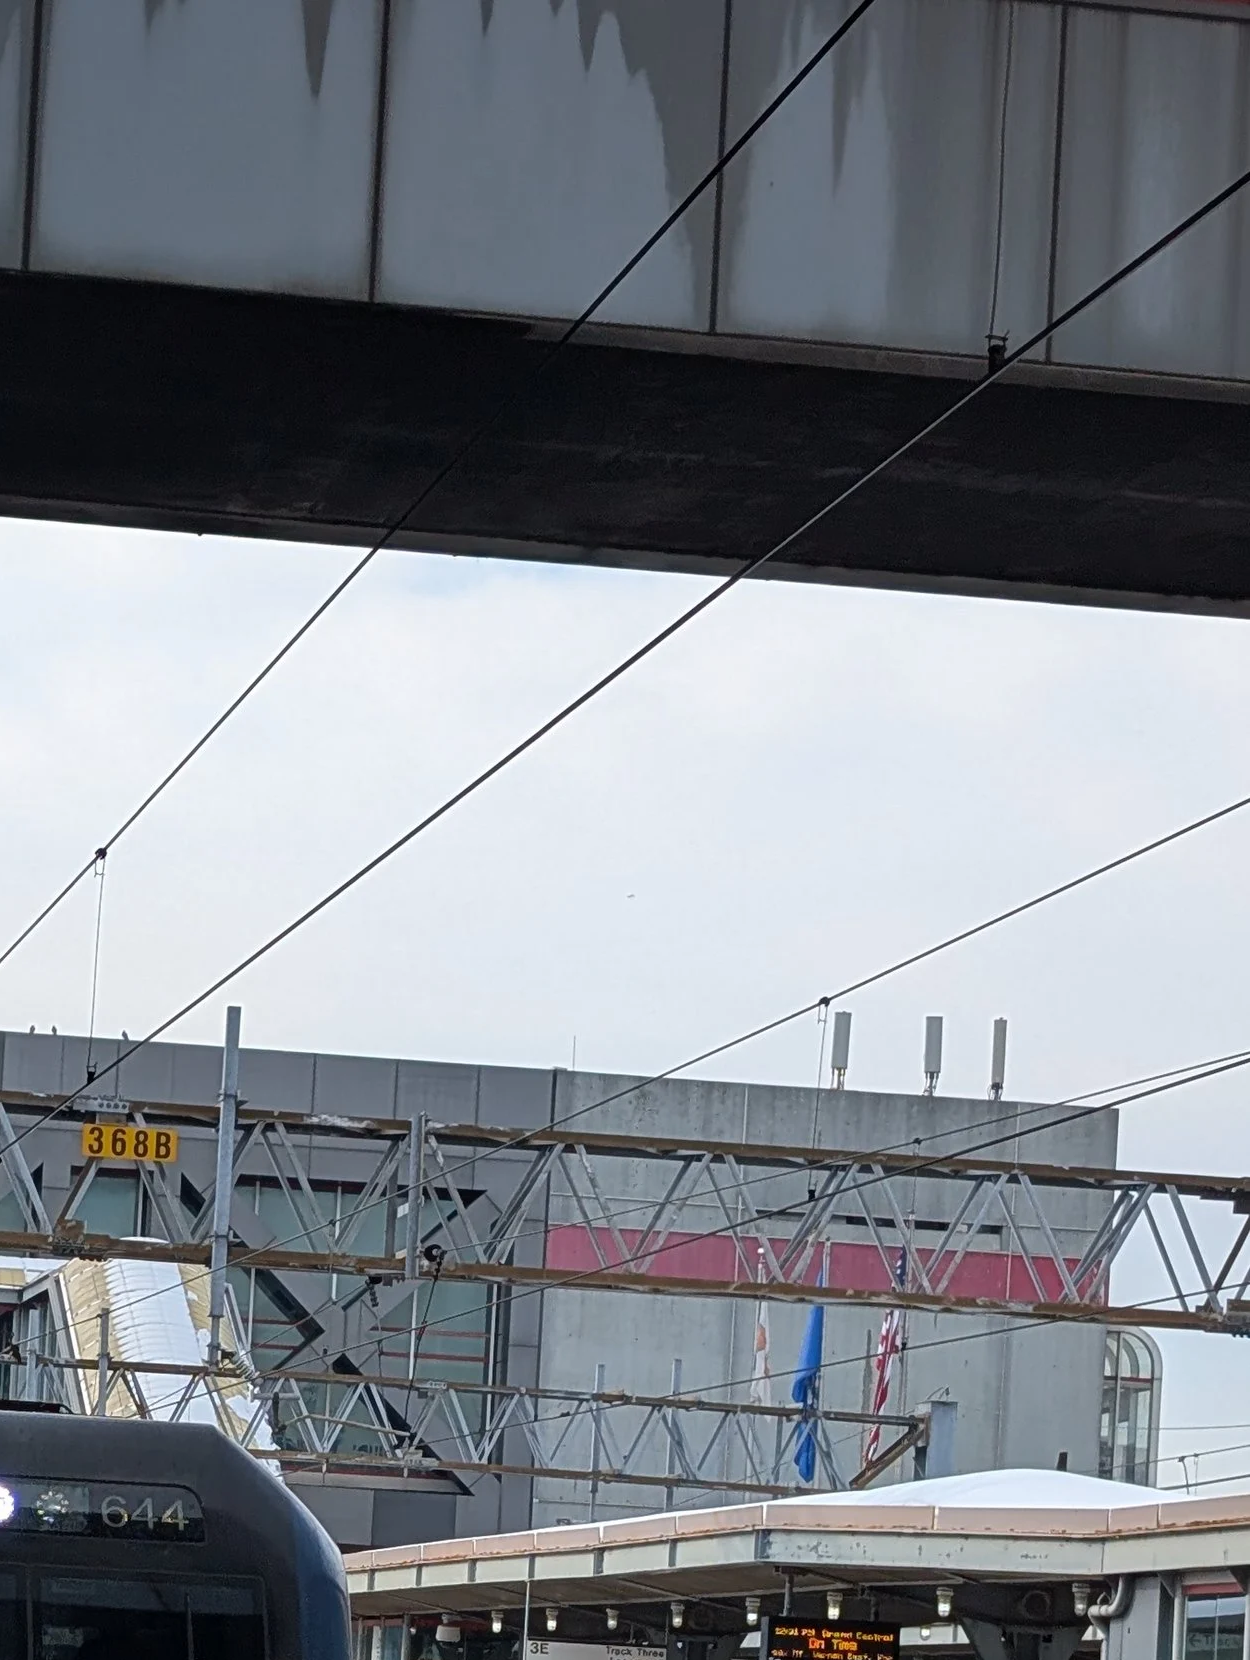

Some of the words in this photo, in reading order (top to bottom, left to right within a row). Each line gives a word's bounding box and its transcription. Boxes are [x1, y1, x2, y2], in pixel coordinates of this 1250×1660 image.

[88, 1126, 171, 1159] 368B
[100, 1495, 190, 1531] 644
[822, 1628, 852, 1639] Grand
[856, 1631, 894, 1642] Central
[530, 1642, 549, 1655] 3E
[606, 1646, 632, 1656] Track
[637, 1648, 664, 1658] Three
[808, 1637, 825, 1649] On
[831, 1639, 858, 1651] Time
[813, 1651, 843, 1660] Vernon
